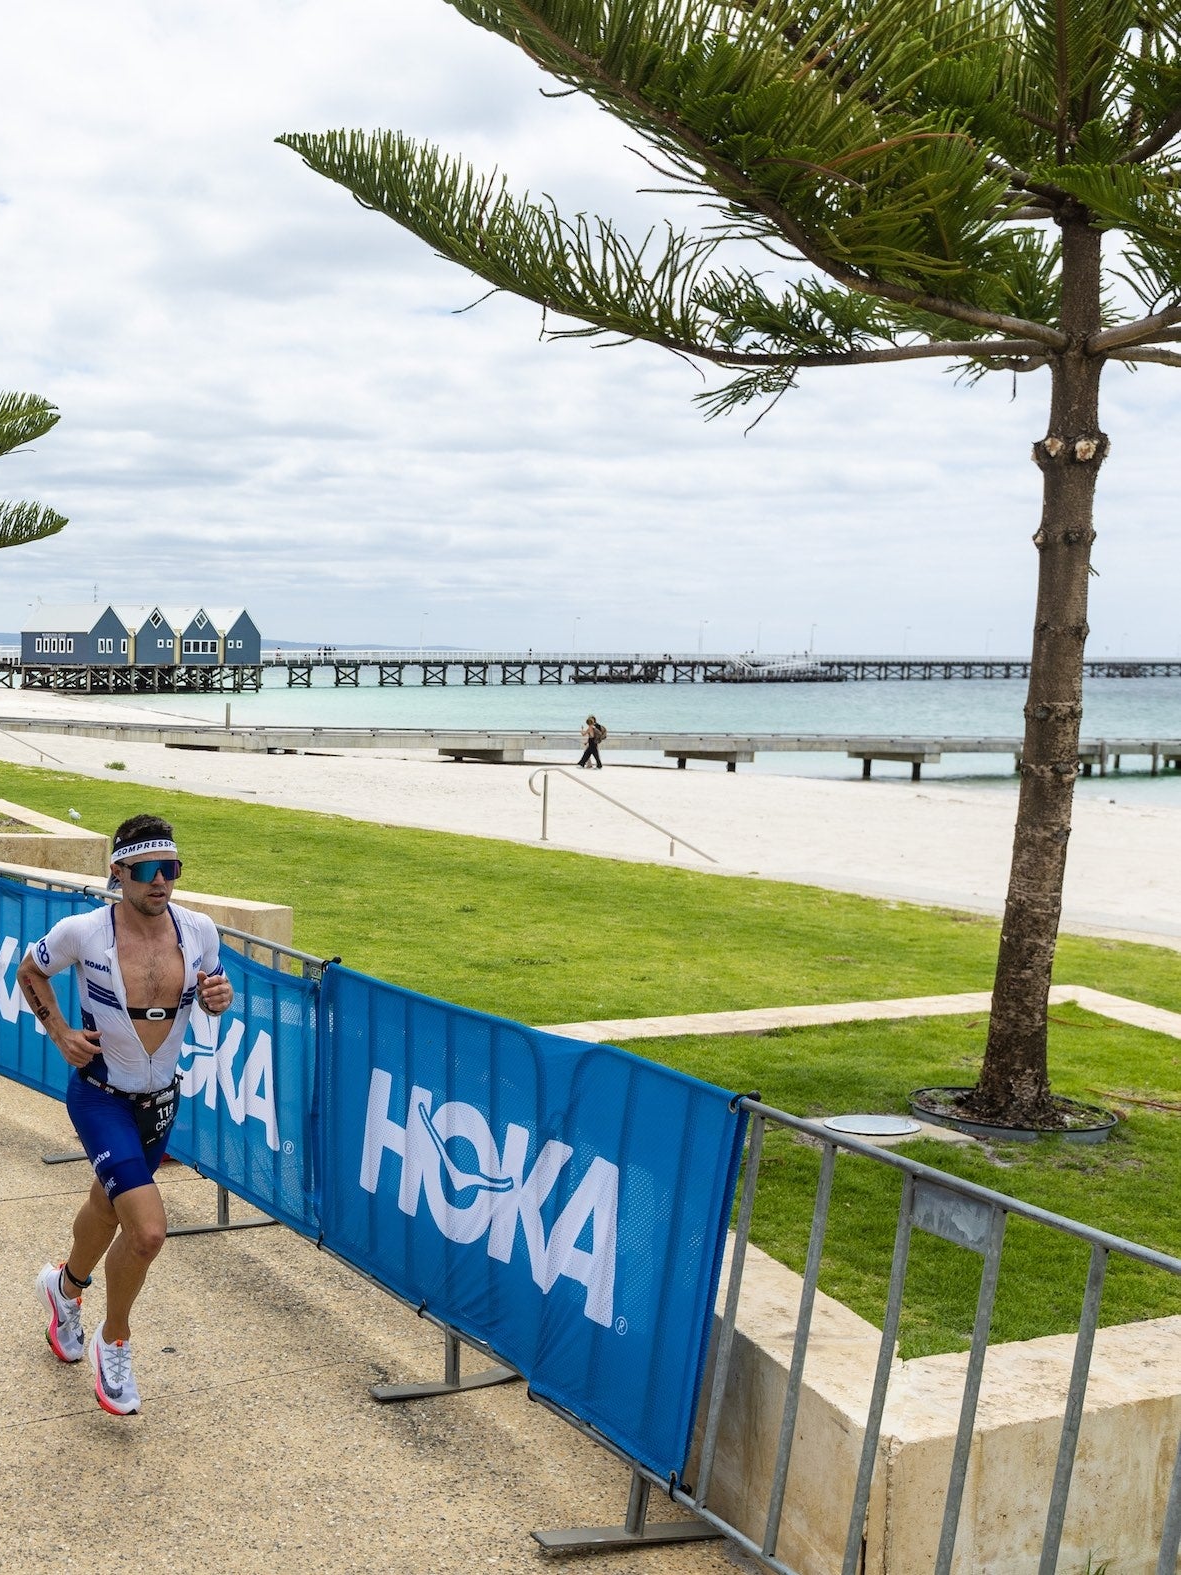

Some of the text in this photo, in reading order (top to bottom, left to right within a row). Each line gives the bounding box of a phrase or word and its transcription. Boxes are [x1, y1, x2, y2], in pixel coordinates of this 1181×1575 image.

[117, 840, 177, 856] COMPRESSP
[84, 959, 112, 975] KOMAT
[176, 1000, 280, 1152] OKA
[359, 1067, 620, 1328] HOKA
